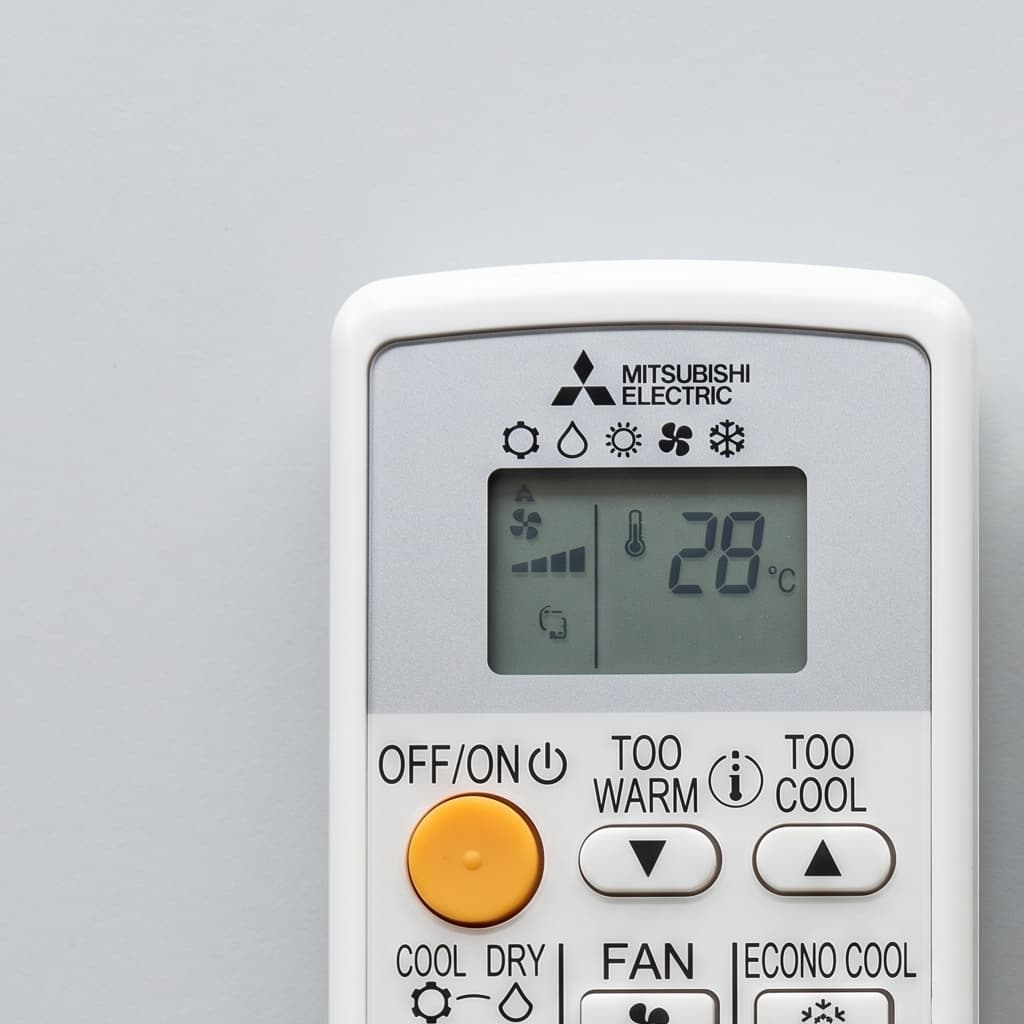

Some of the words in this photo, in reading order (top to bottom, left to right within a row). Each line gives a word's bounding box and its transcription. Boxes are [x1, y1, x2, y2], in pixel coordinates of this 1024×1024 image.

[622, 364, 751, 384] MITSUBISHI
[622, 386, 733, 406] ELECTRIC
[669, 512, 765, 594] 28
[378, 744, 520, 785] OFF/ON
[612, 735, 682, 771] TOO
[785, 734, 854, 769] TOO
[594, 778, 699, 813] WARM
[776, 777, 867, 813] COOL
[396, 944, 466, 977] COOL
[487, 943, 546, 976] DRY
[602, 943, 695, 980] FAN
[745, 942, 836, 978] ECONO
[845, 942, 917, 978] COOL
